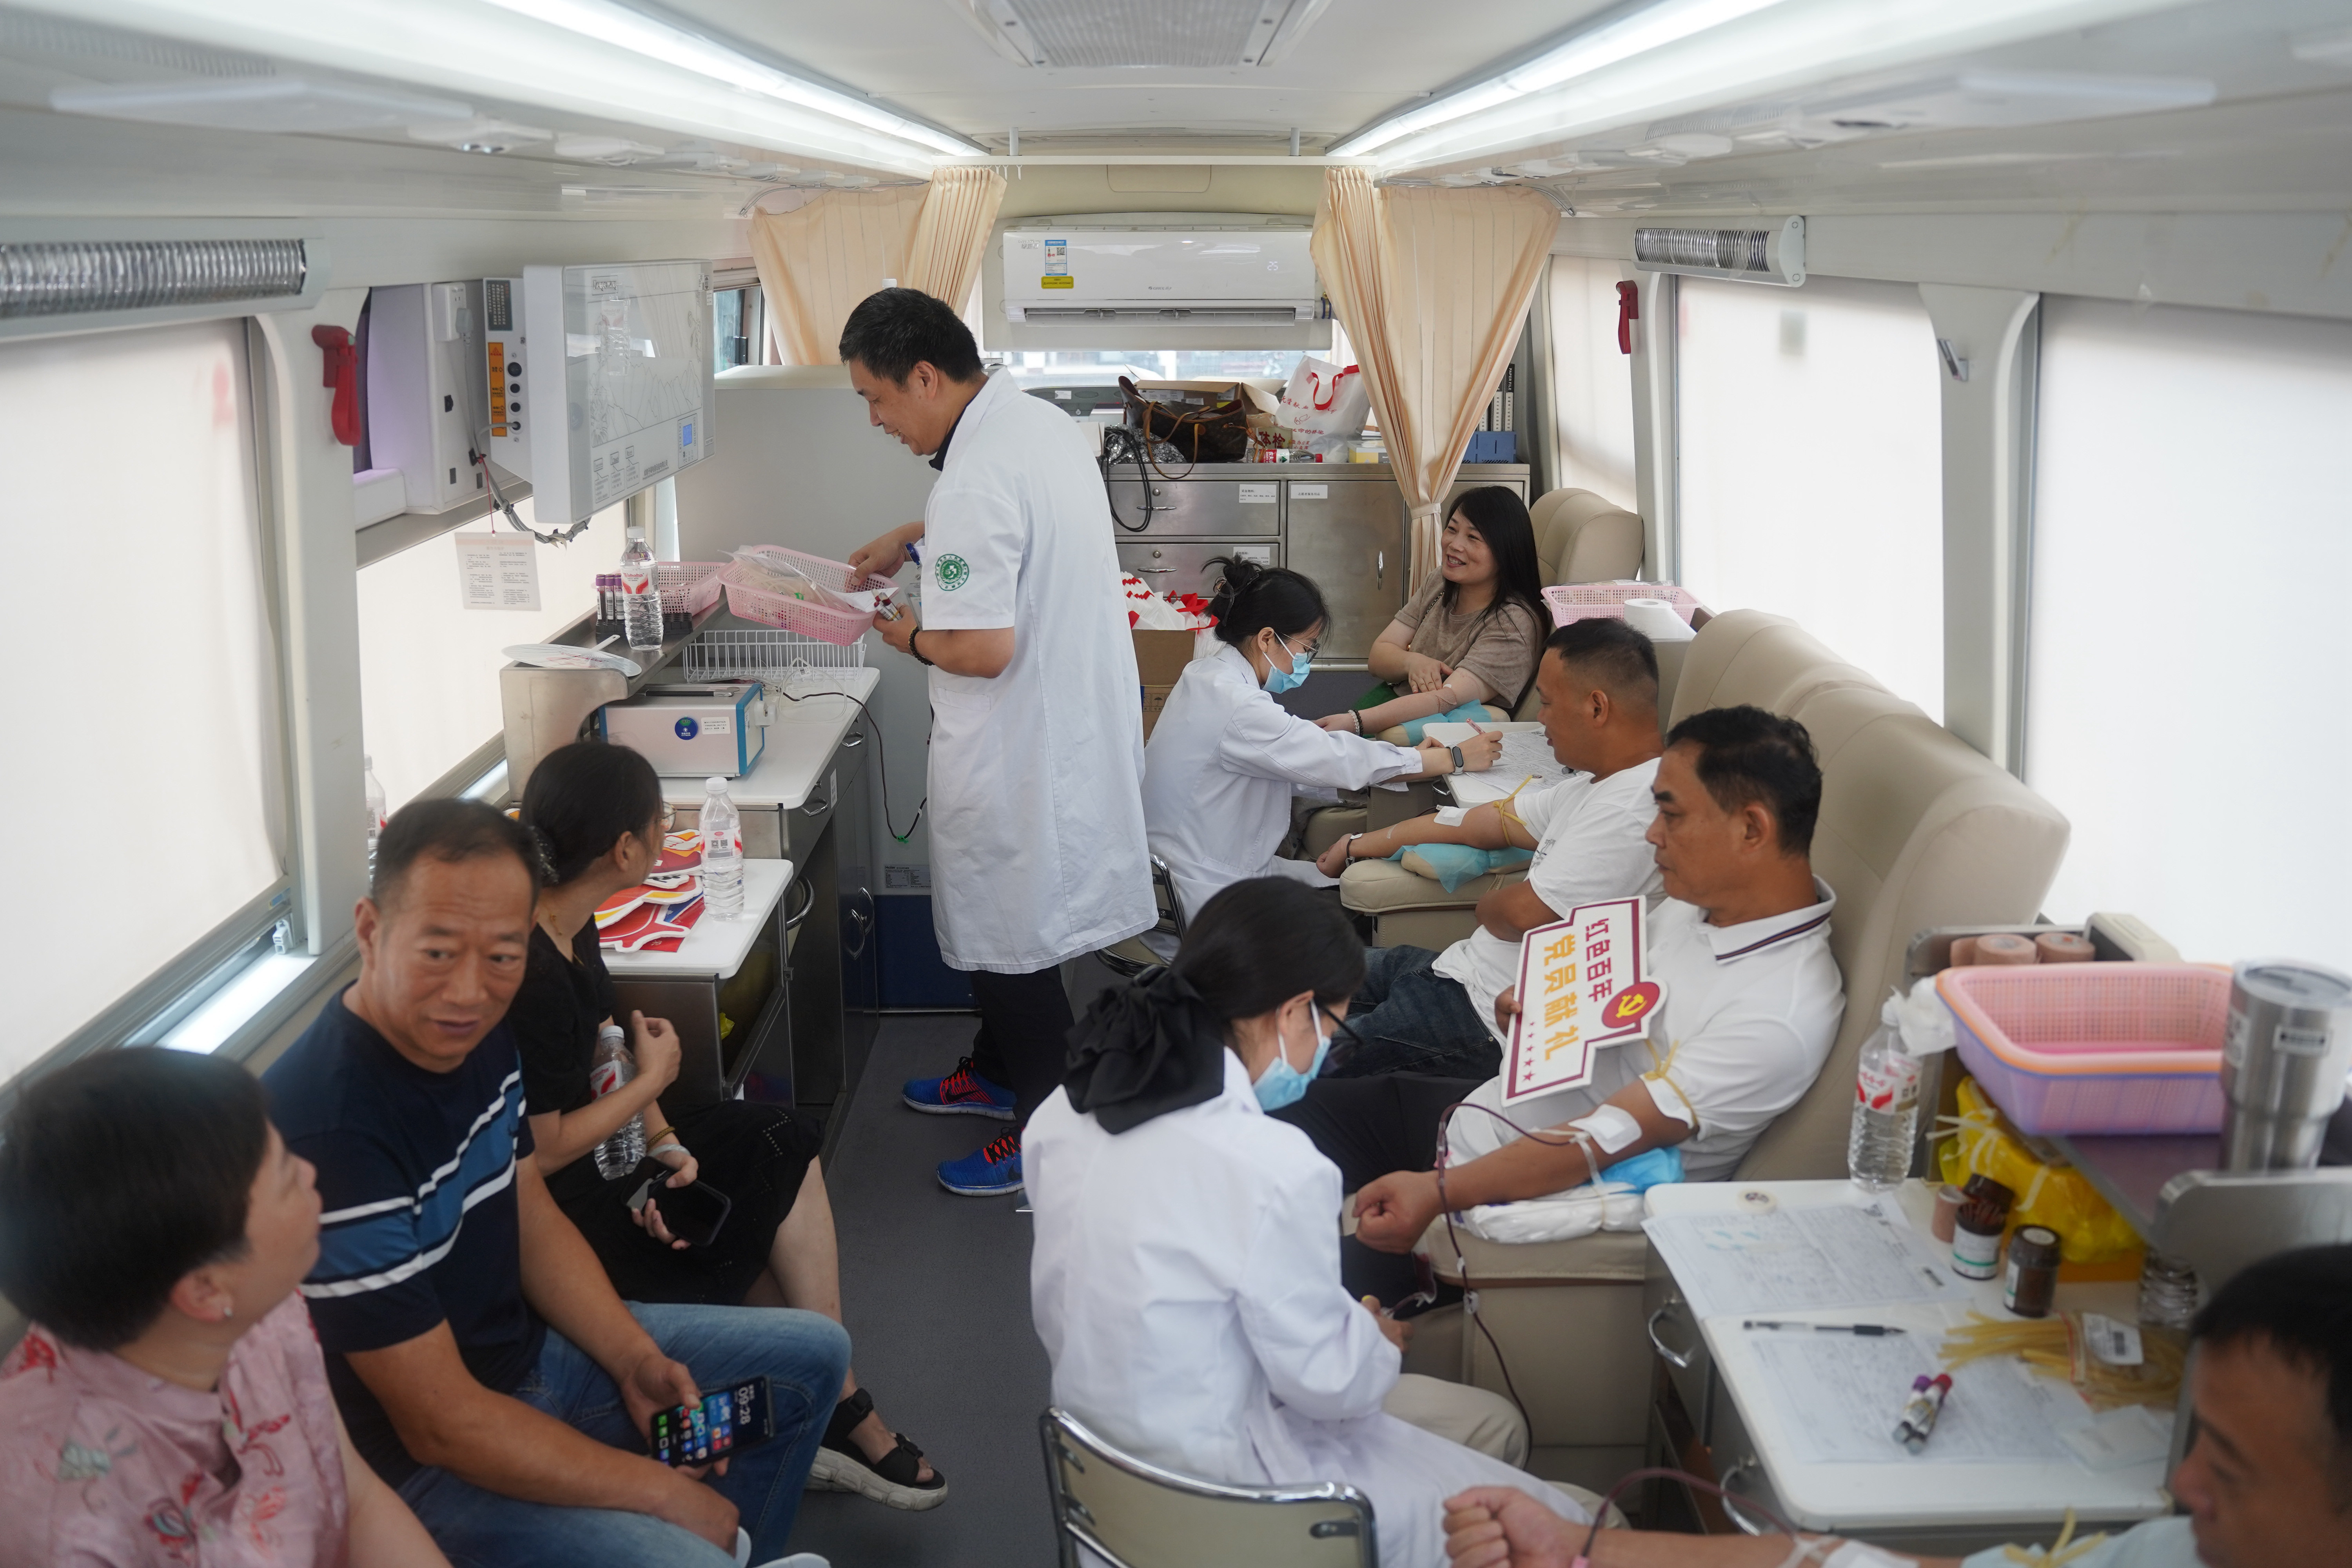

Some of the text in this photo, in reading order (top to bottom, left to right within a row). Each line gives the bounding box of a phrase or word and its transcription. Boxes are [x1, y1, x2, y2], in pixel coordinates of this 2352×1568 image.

[1267, 261, 1278, 270] 25
[1281, 396, 1309, 410] 无偿献血
[1259, 431, 1285, 448] 体检
[1585, 918, 1612, 1002] 红色百年
[1544, 934, 1579, 1060] 党员献礼
